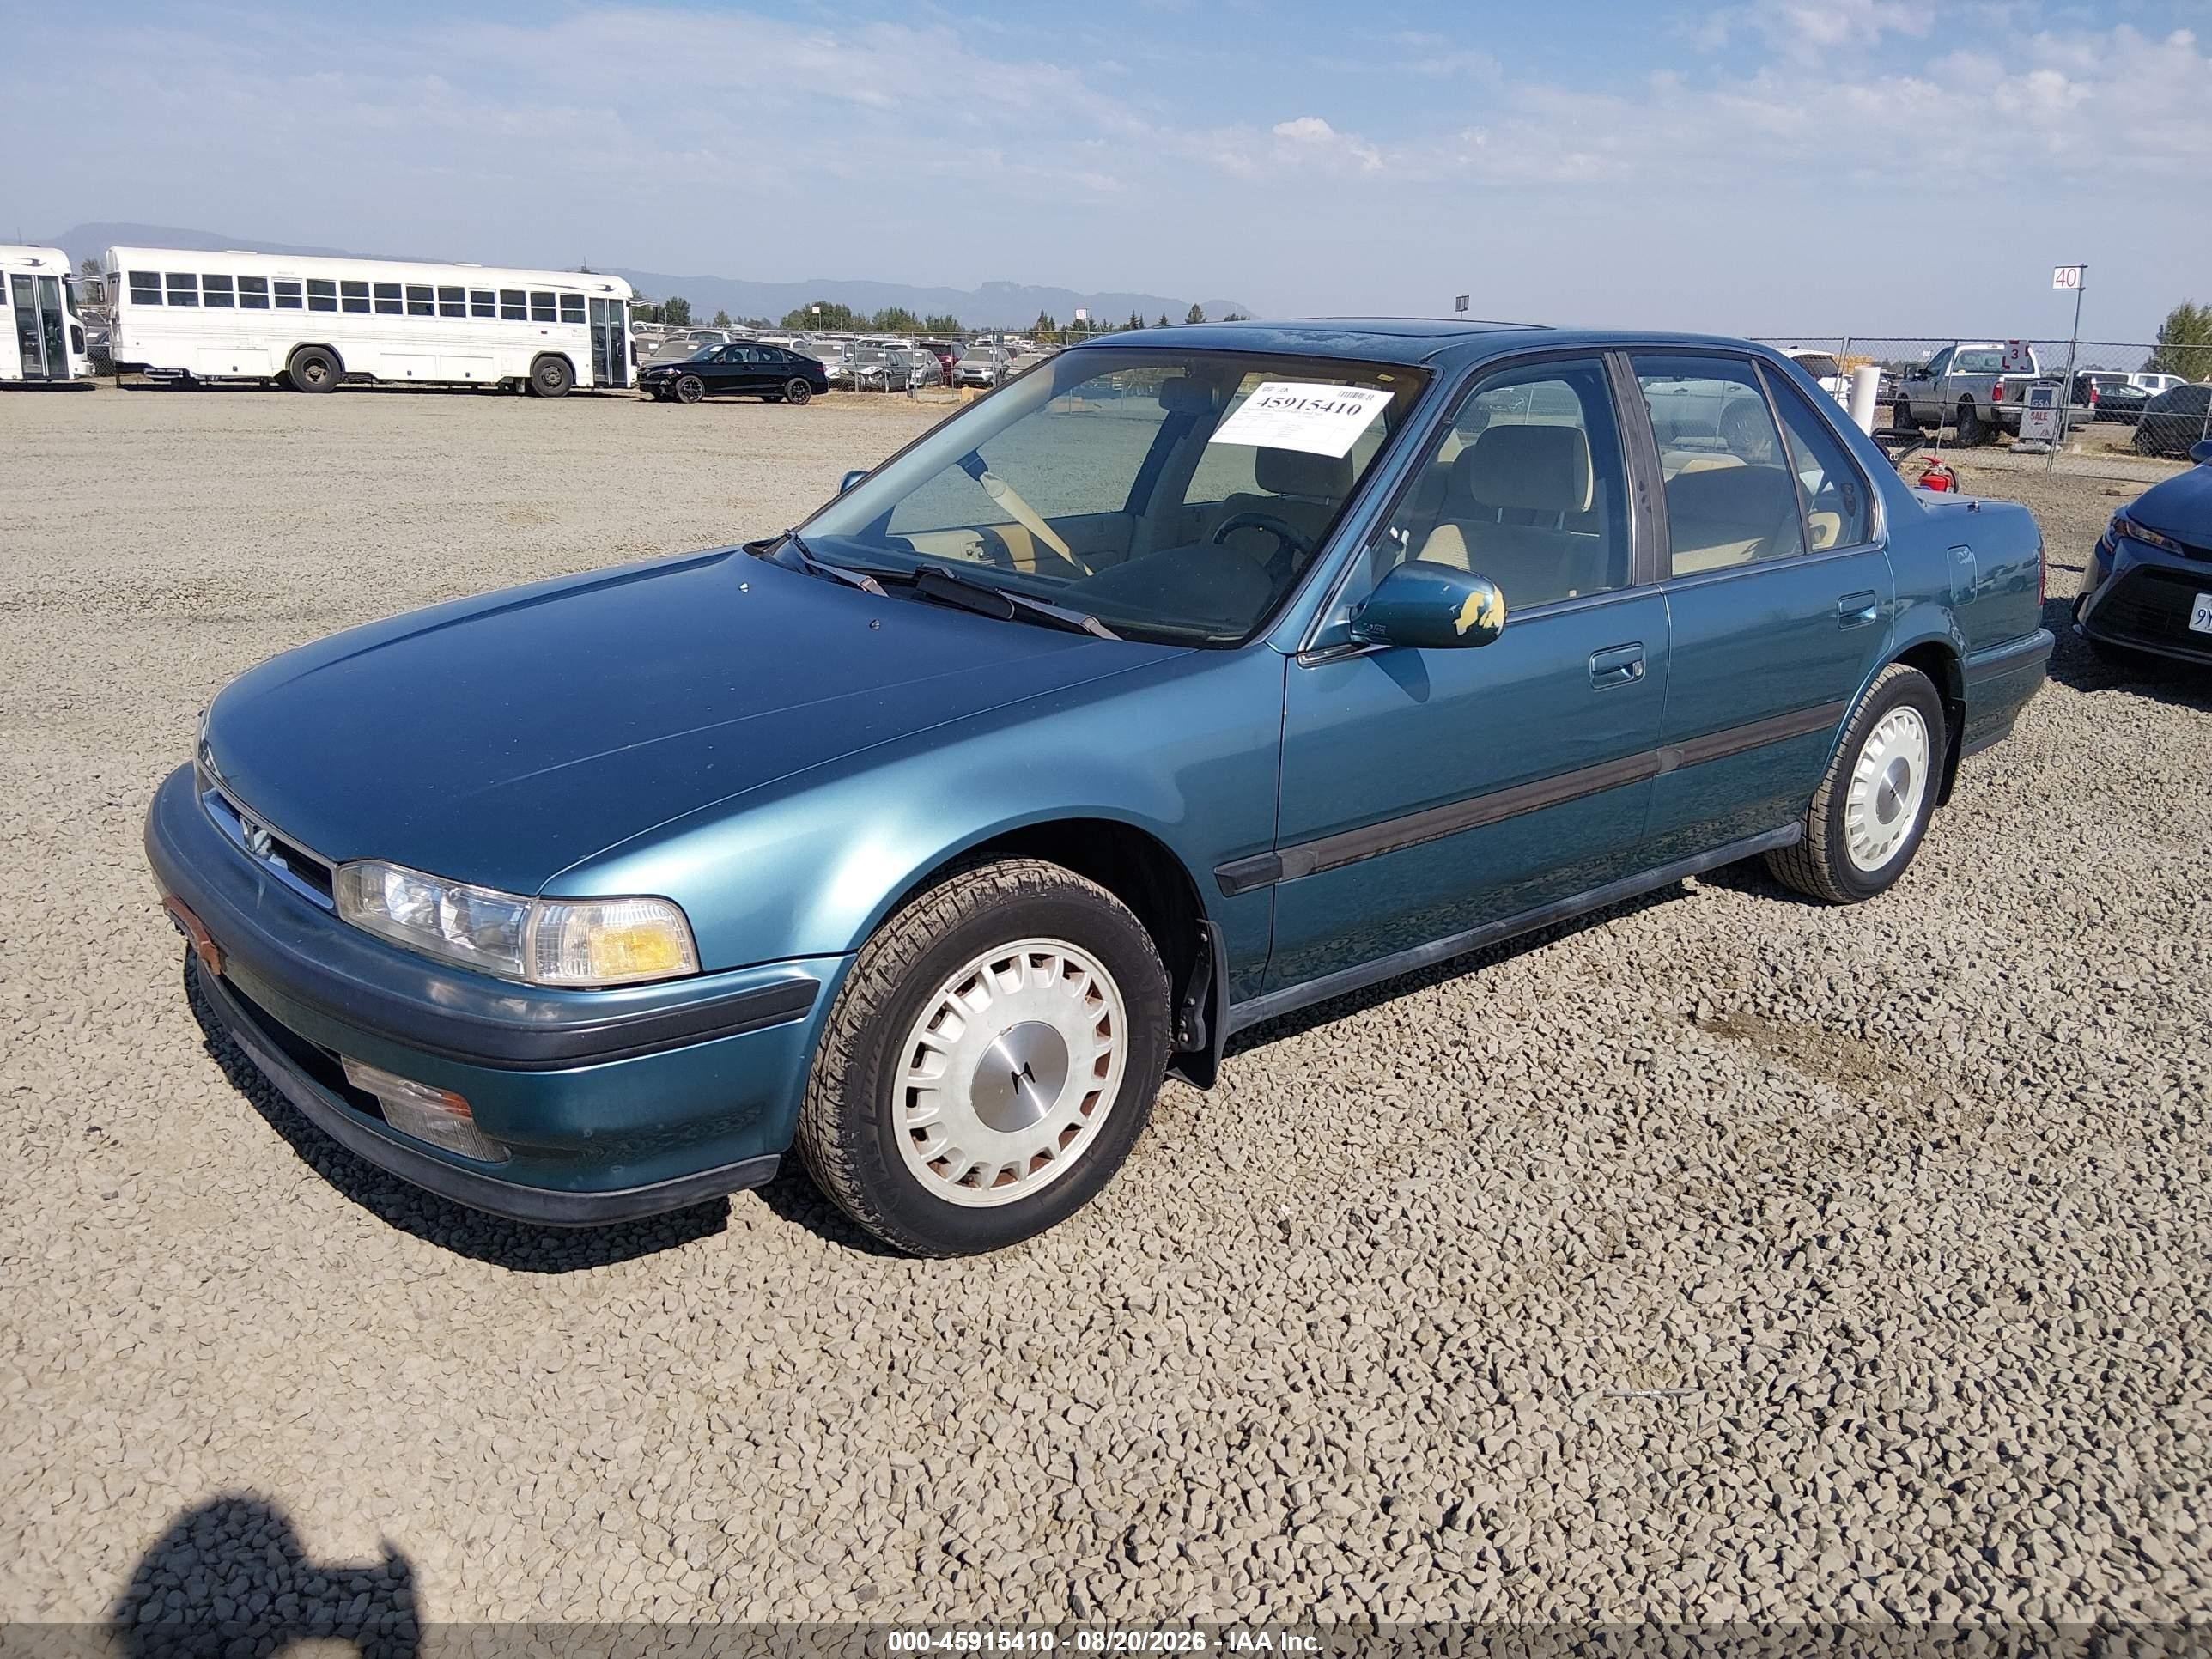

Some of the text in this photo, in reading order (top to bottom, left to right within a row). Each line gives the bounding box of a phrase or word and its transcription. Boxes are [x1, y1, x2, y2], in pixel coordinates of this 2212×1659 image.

[2056, 268, 2076, 287] 40
[1256, 396, 1362, 416] 45915410
[2032, 399, 2050, 408] GSA
[2031, 411, 2048, 421] SALE
